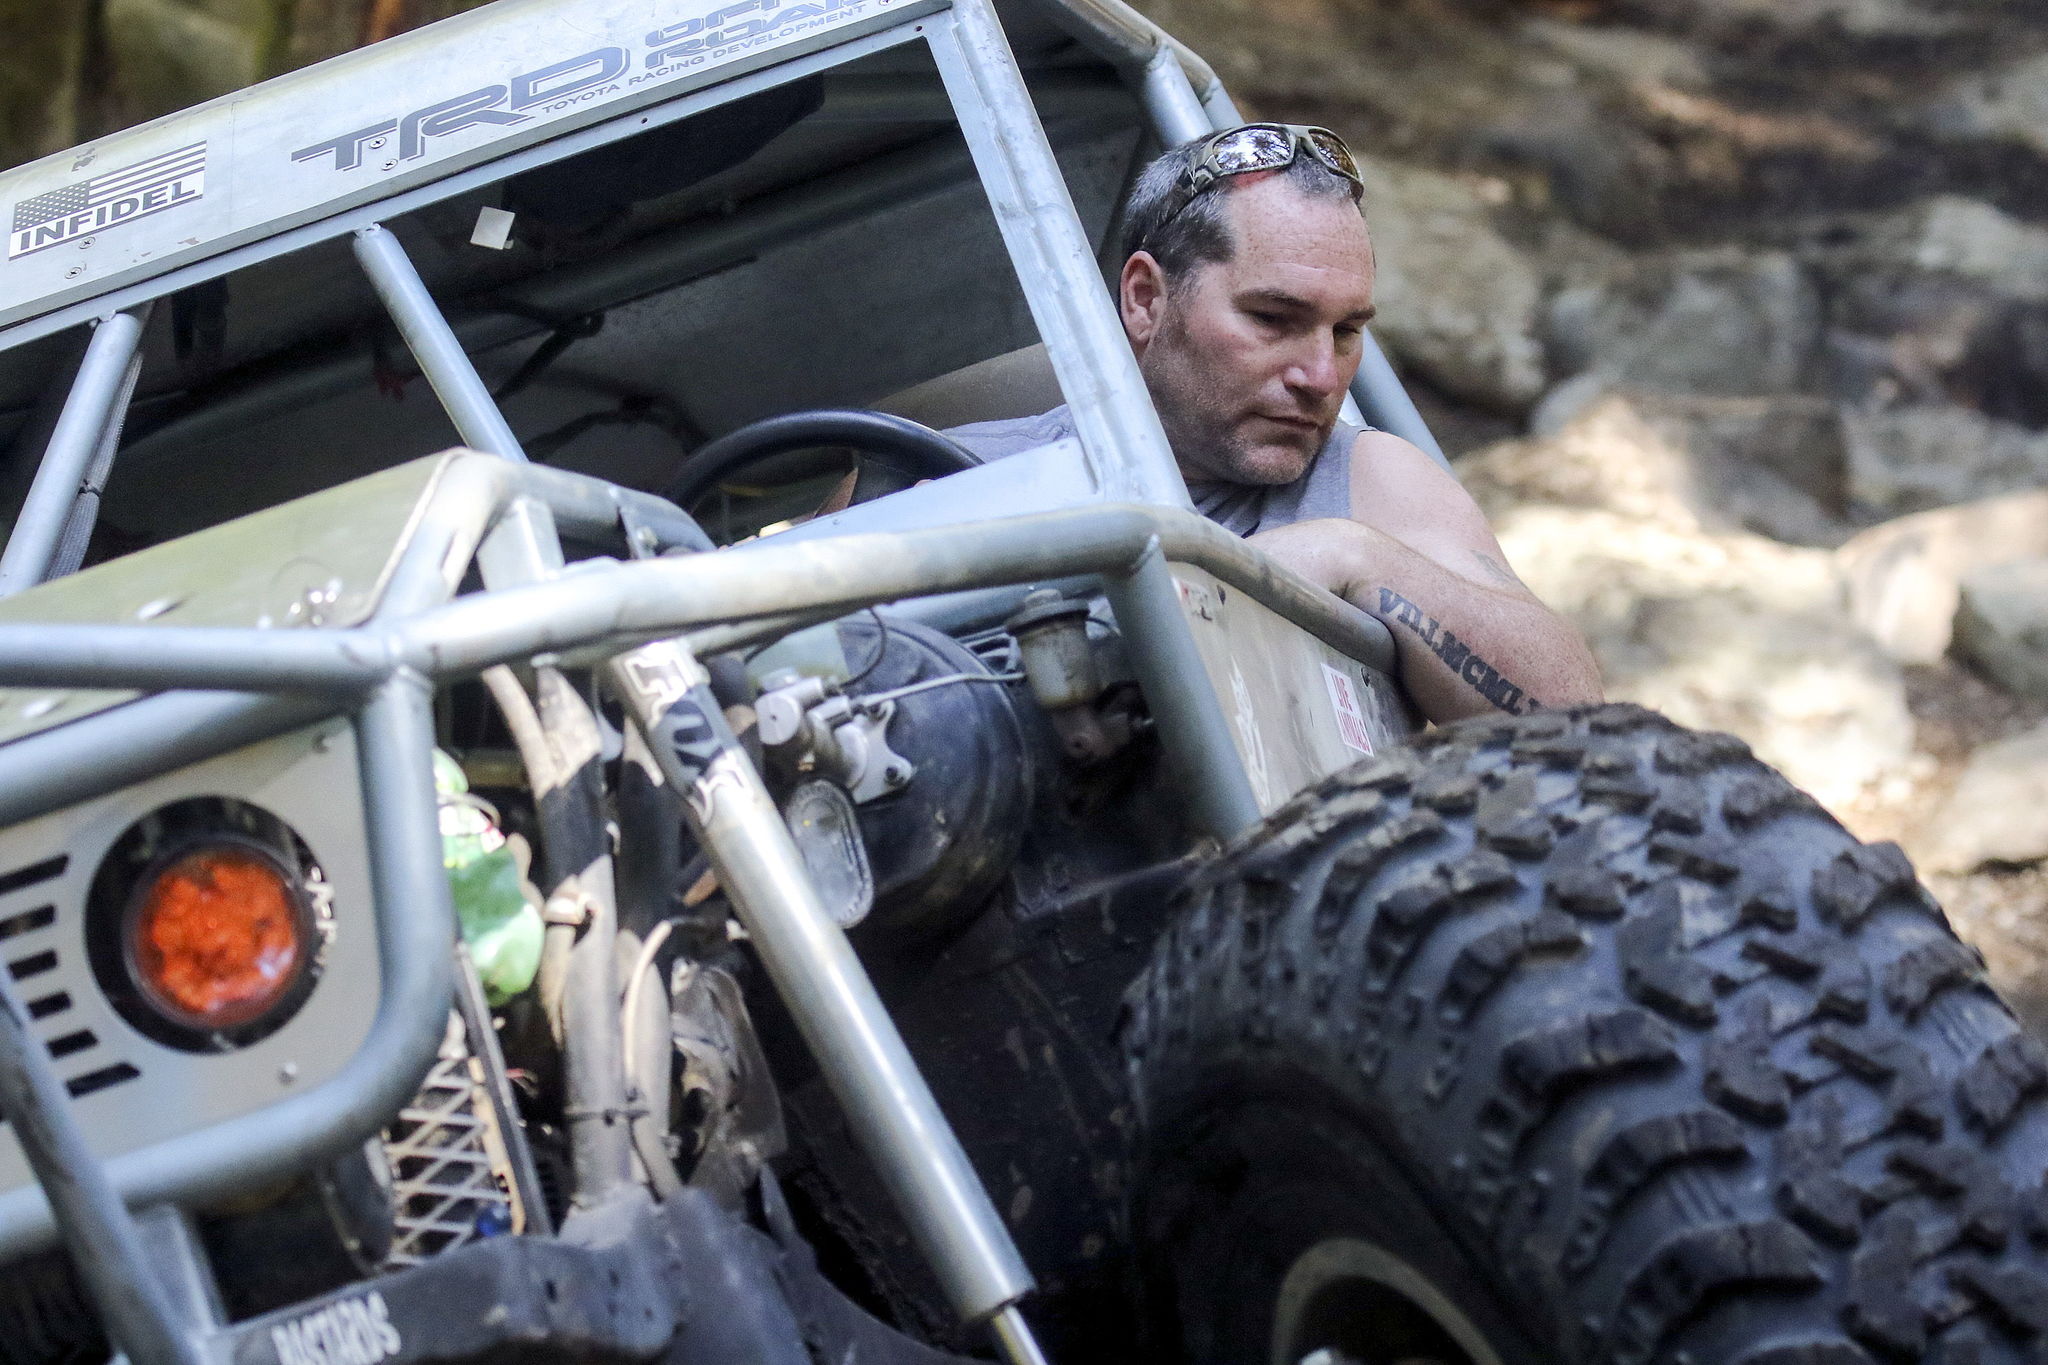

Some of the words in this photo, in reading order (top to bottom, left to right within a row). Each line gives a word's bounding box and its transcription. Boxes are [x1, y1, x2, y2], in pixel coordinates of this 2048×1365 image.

[291, 46, 631, 173] TRD
[541, 83, 621, 115] TOYOTA
[628, 56, 705, 86] RACING
[712, 5, 865, 59] DEVELOPMENT
[20, 180, 196, 251] INFIDEL
